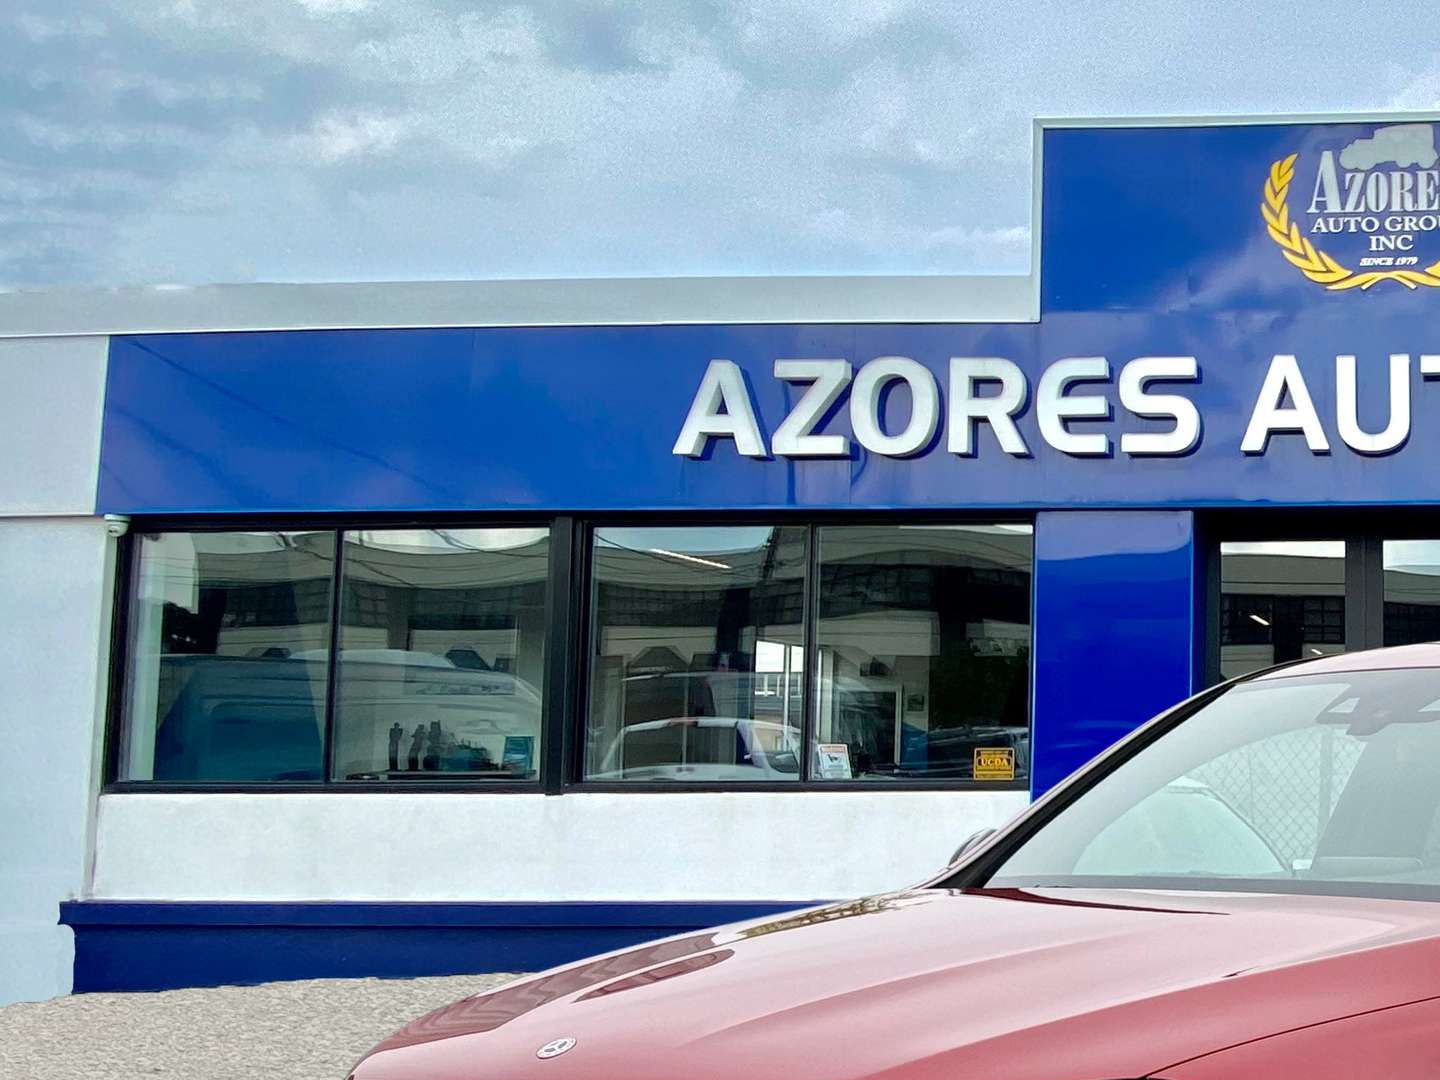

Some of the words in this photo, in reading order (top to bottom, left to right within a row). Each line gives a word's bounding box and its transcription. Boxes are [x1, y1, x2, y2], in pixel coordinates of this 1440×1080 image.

[1311, 216, 1381, 233] AUTO
[1369, 235, 1414, 251] INC
[1360, 257, 1394, 266] SINCE
[1395, 256, 1419, 266] 1979
[673, 356, 1202, 458] AZORES
[981, 757, 1010, 768] UCDA
